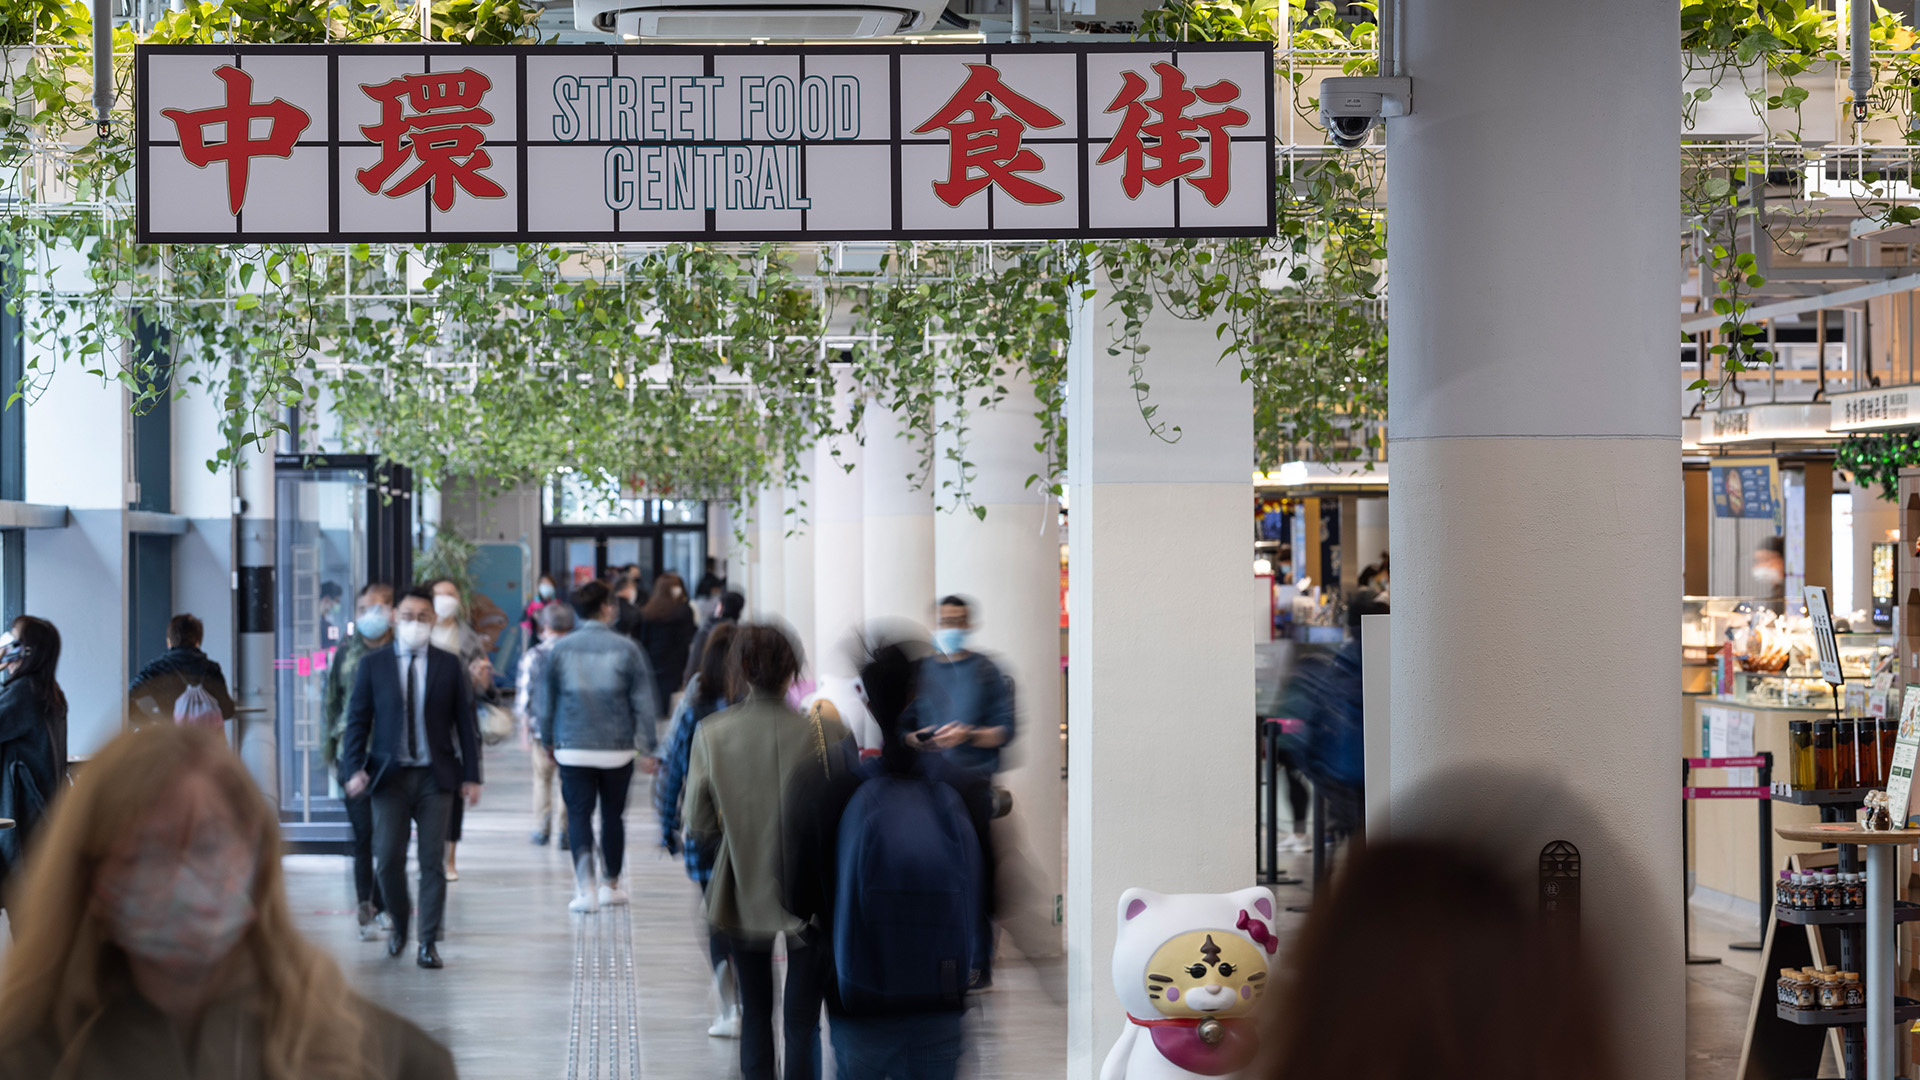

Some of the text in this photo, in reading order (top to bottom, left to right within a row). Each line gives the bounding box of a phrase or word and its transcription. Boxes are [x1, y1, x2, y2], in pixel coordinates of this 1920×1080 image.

[551, 73, 861, 142] STREET FOOD
[603, 144, 812, 212] CENTRAL
